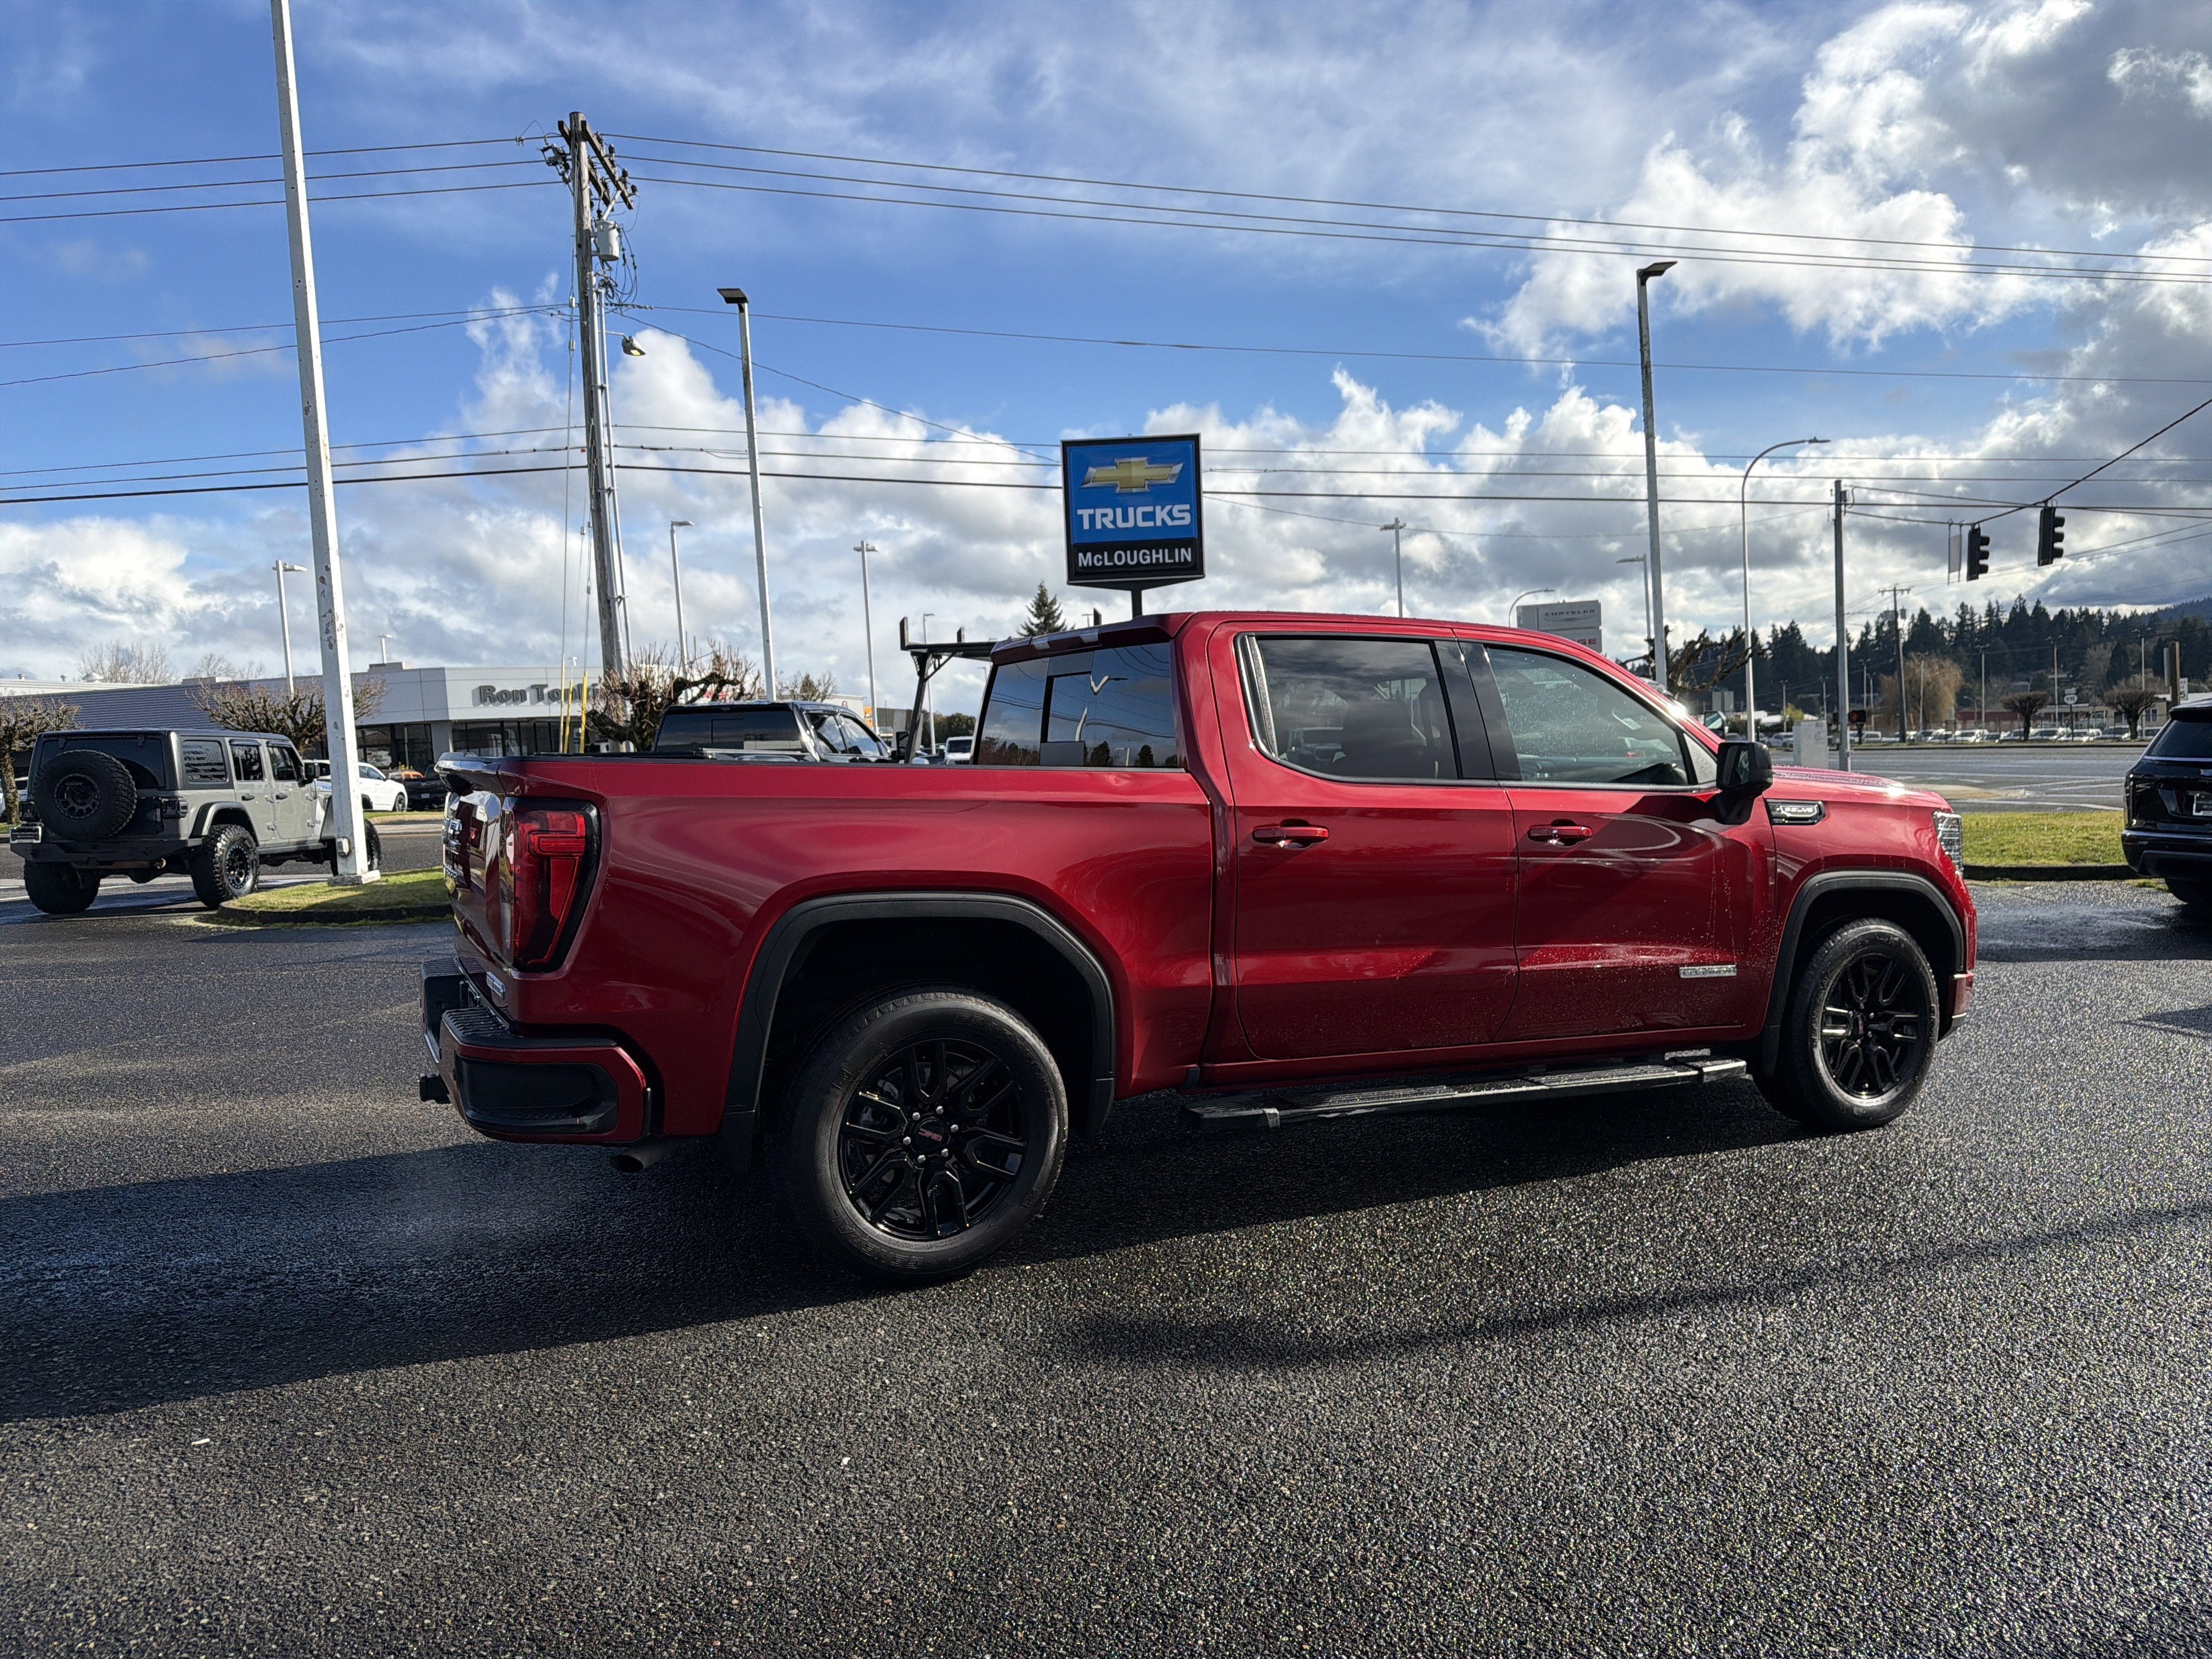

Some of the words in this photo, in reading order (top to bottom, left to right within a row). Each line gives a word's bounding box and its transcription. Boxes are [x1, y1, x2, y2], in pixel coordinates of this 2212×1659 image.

[1077, 504, 1191, 530] TRUCKS
[1078, 547, 1192, 567] McLOUGHLIN
[478, 685, 527, 704] Ron
